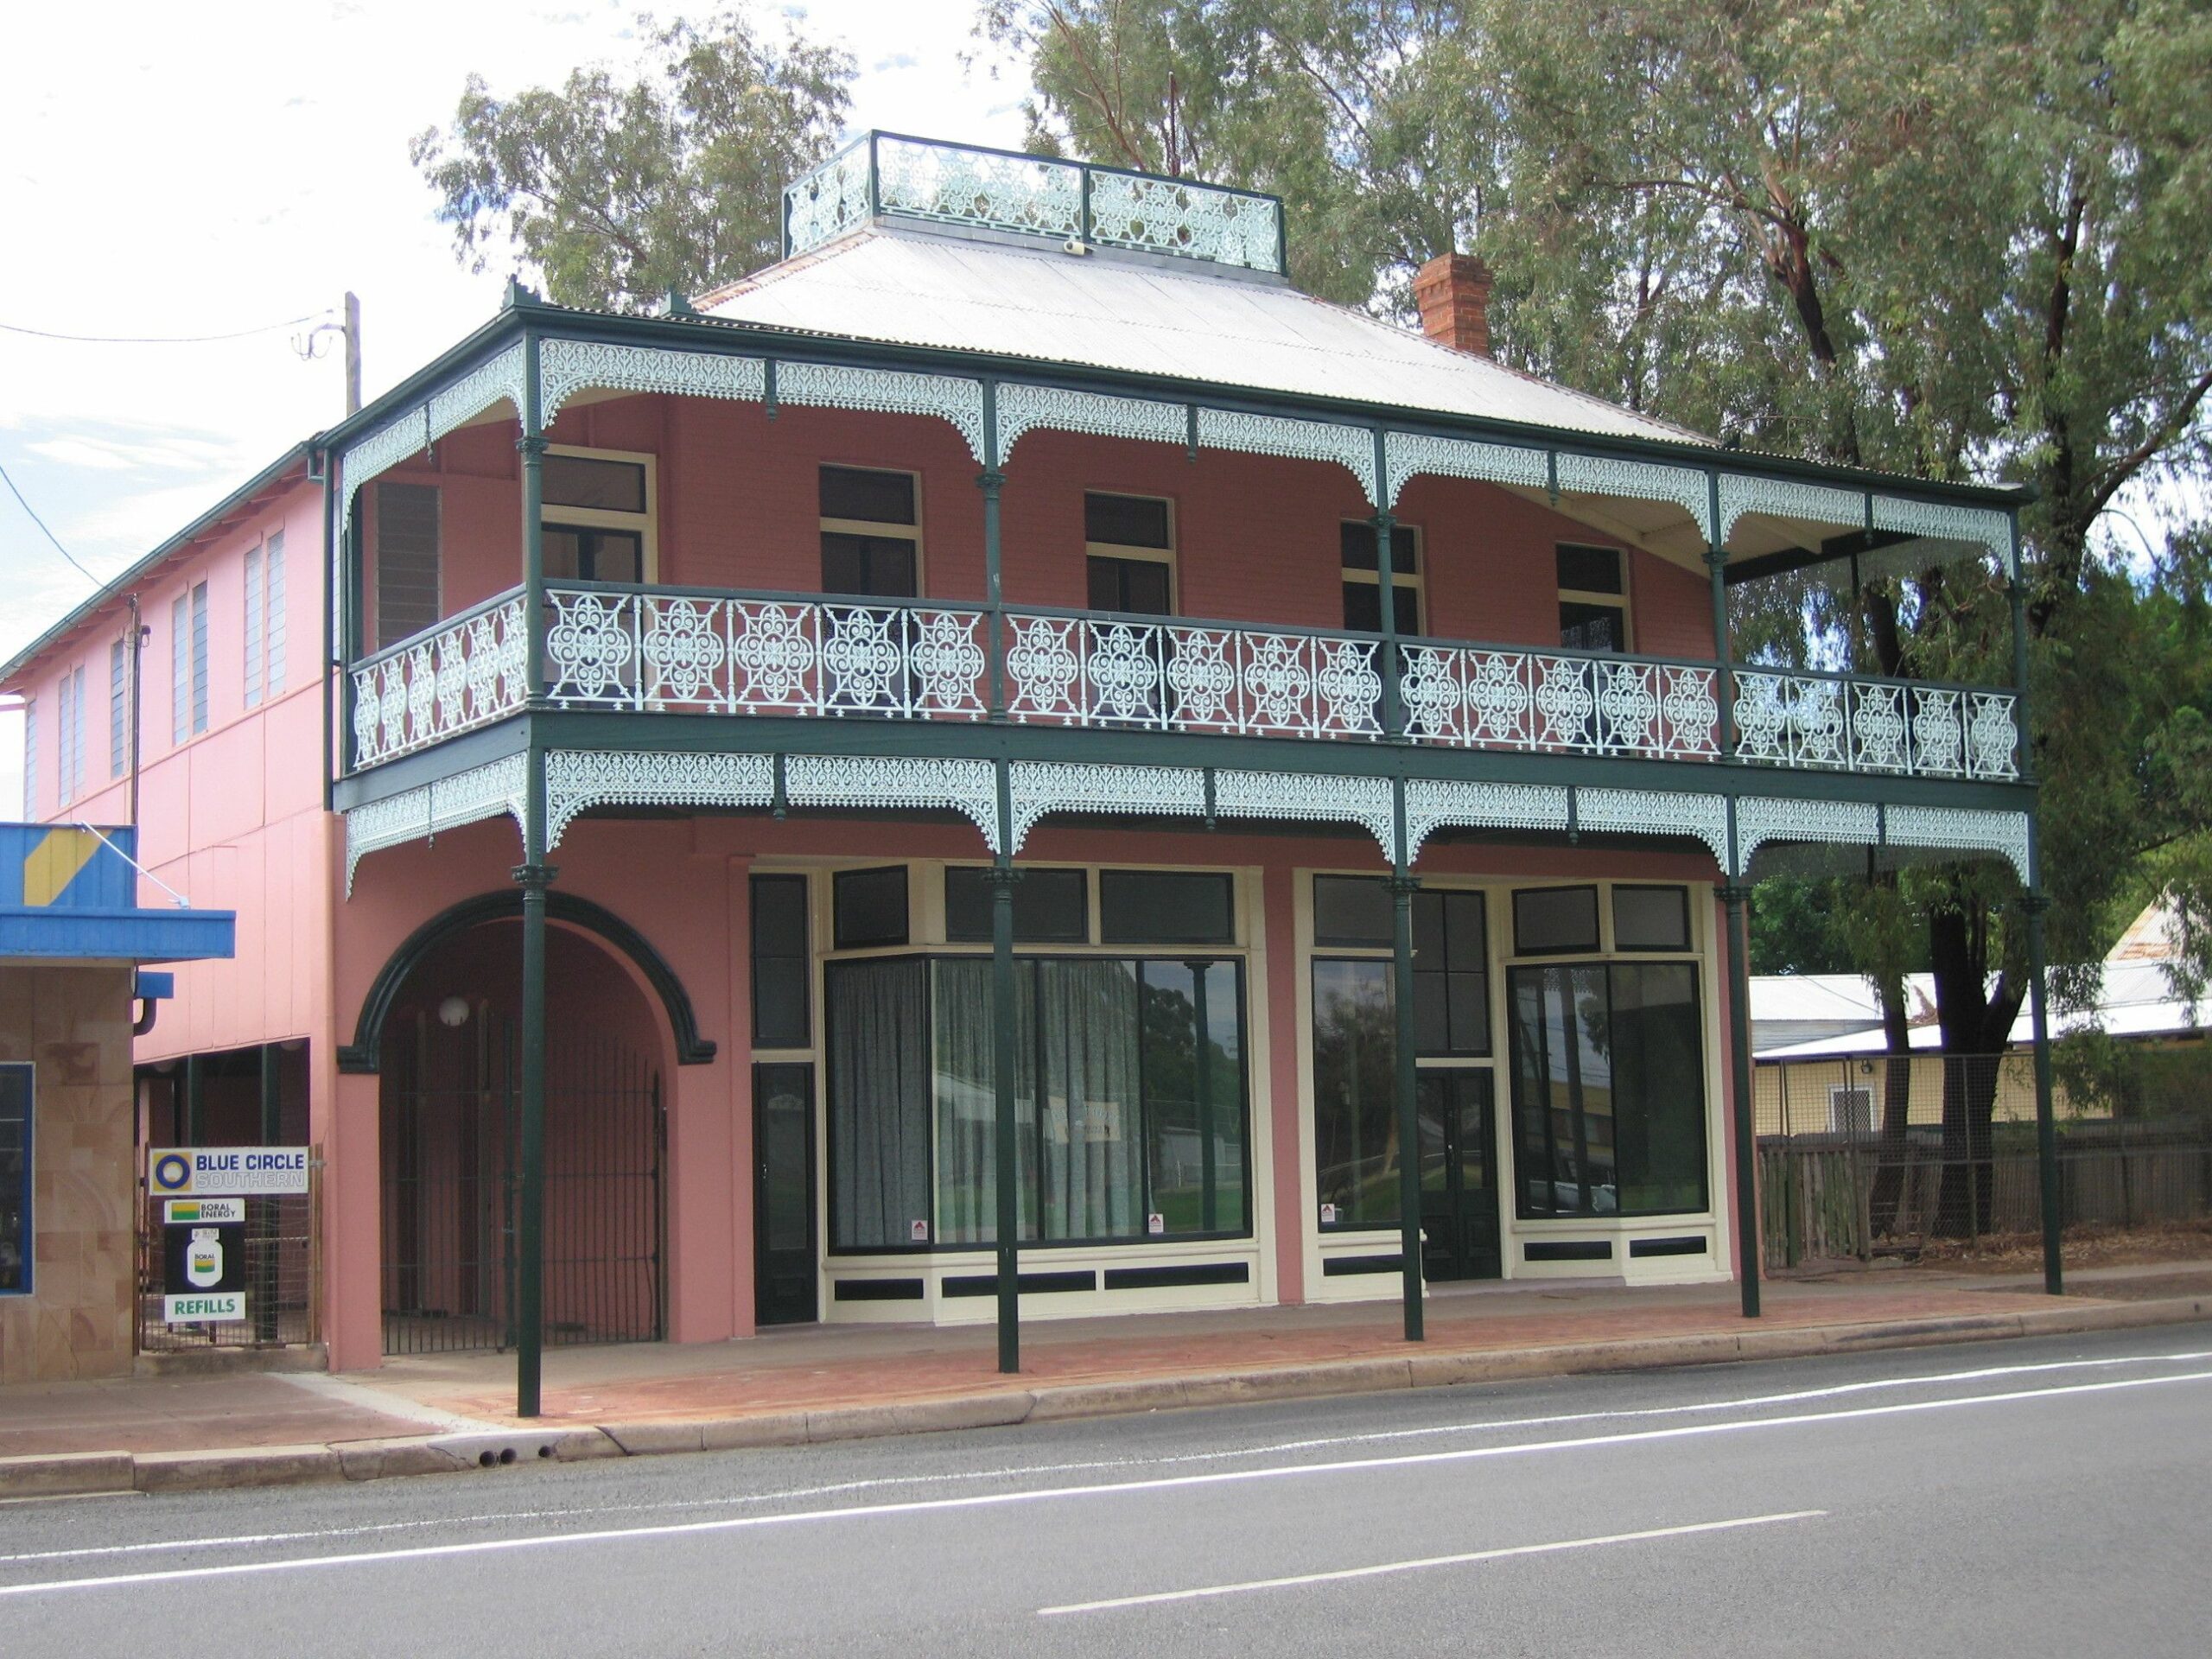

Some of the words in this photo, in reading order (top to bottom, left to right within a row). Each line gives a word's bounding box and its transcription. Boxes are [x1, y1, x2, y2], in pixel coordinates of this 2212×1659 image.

[196, 1155, 239, 1171] BLUE
[246, 1154, 304, 1170] CIRCLE
[196, 1172, 304, 1188] SOUTHERN
[200, 1203, 231, 1211] BORAL
[200, 1210, 236, 1218] ENERGY
[175, 1299, 236, 1315] REFILLS
